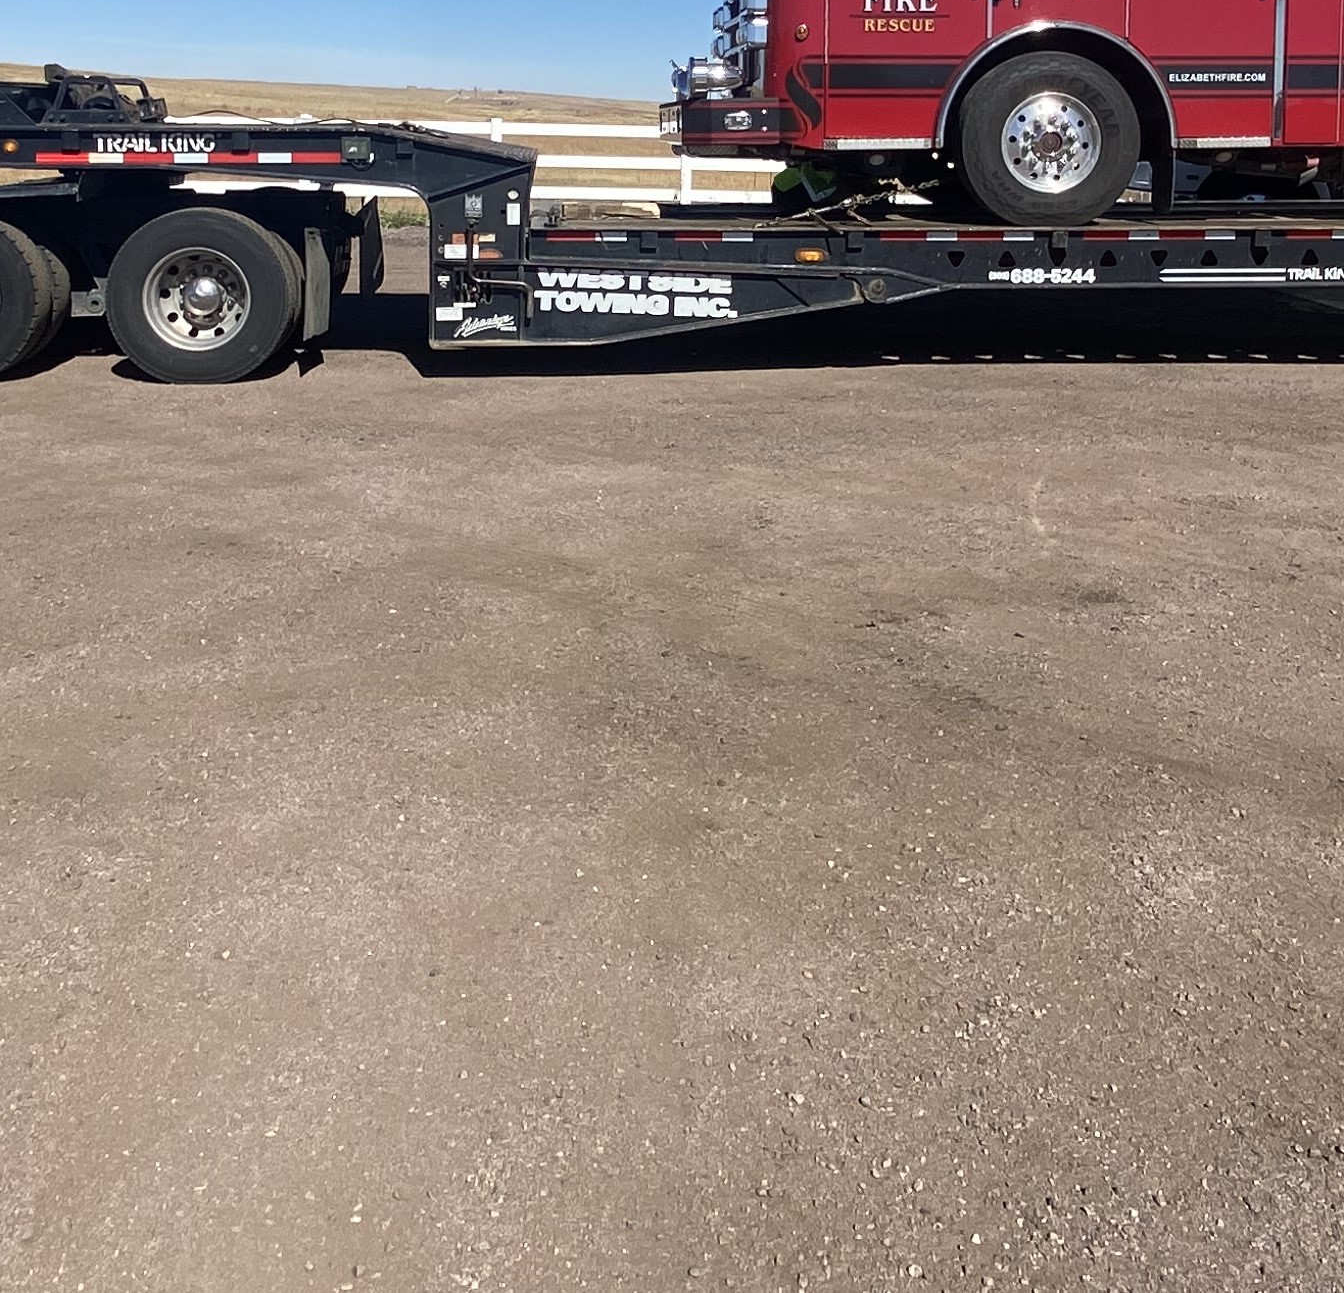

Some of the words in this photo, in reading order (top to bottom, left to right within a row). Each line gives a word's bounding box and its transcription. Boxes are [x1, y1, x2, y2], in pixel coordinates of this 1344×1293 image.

[864, 18, 936, 32] RESCUE
[1168, 72, 1267, 83] ELIZABETHFIRE.COM
[93, 132, 158, 153] TRAIL
[160, 132, 216, 153] KING
[1010, 268, 1096, 284] 688-5244
[1287, 267, 1324, 281] TRAIL
[533, 290, 670, 316] TOWING
[673, 296, 739, 318] INC.
